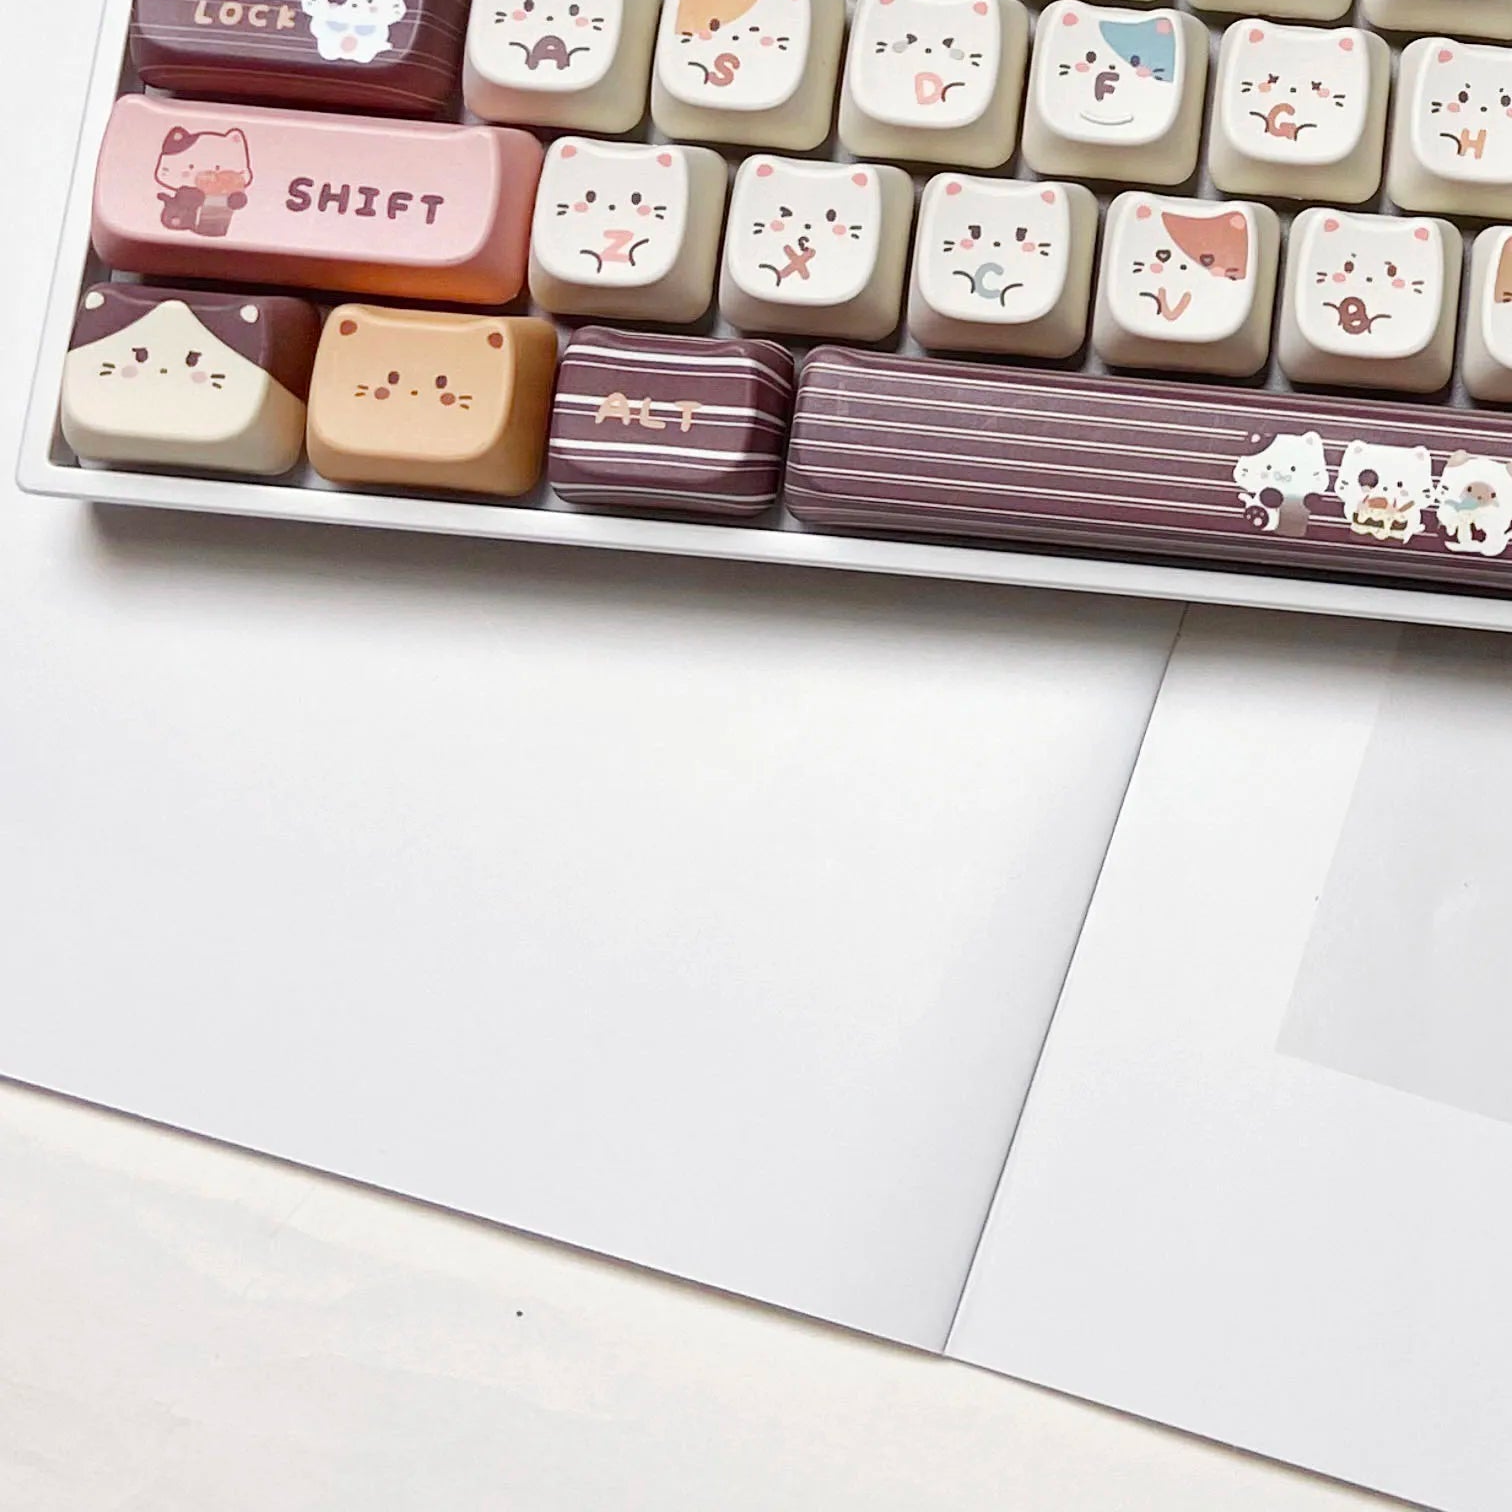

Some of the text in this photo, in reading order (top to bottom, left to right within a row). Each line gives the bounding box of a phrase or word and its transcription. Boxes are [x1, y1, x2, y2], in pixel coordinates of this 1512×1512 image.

[194, 0, 297, 31] LOCK
[524, 34, 571, 70] A
[707, 53, 740, 87] S
[1094, 71, 1121, 102] F
[914, 72, 944, 105] D
[1266, 103, 1297, 138] G
[1458, 128, 1487, 160] H
[285, 176, 445, 226] SHIFT
[602, 229, 636, 265] Z
[780, 242, 817, 281] X
[975, 262, 1005, 299] C
[1157, 287, 1192, 321] V
[1338, 296, 1371, 335] B
[594, 391, 704, 433] ALT
